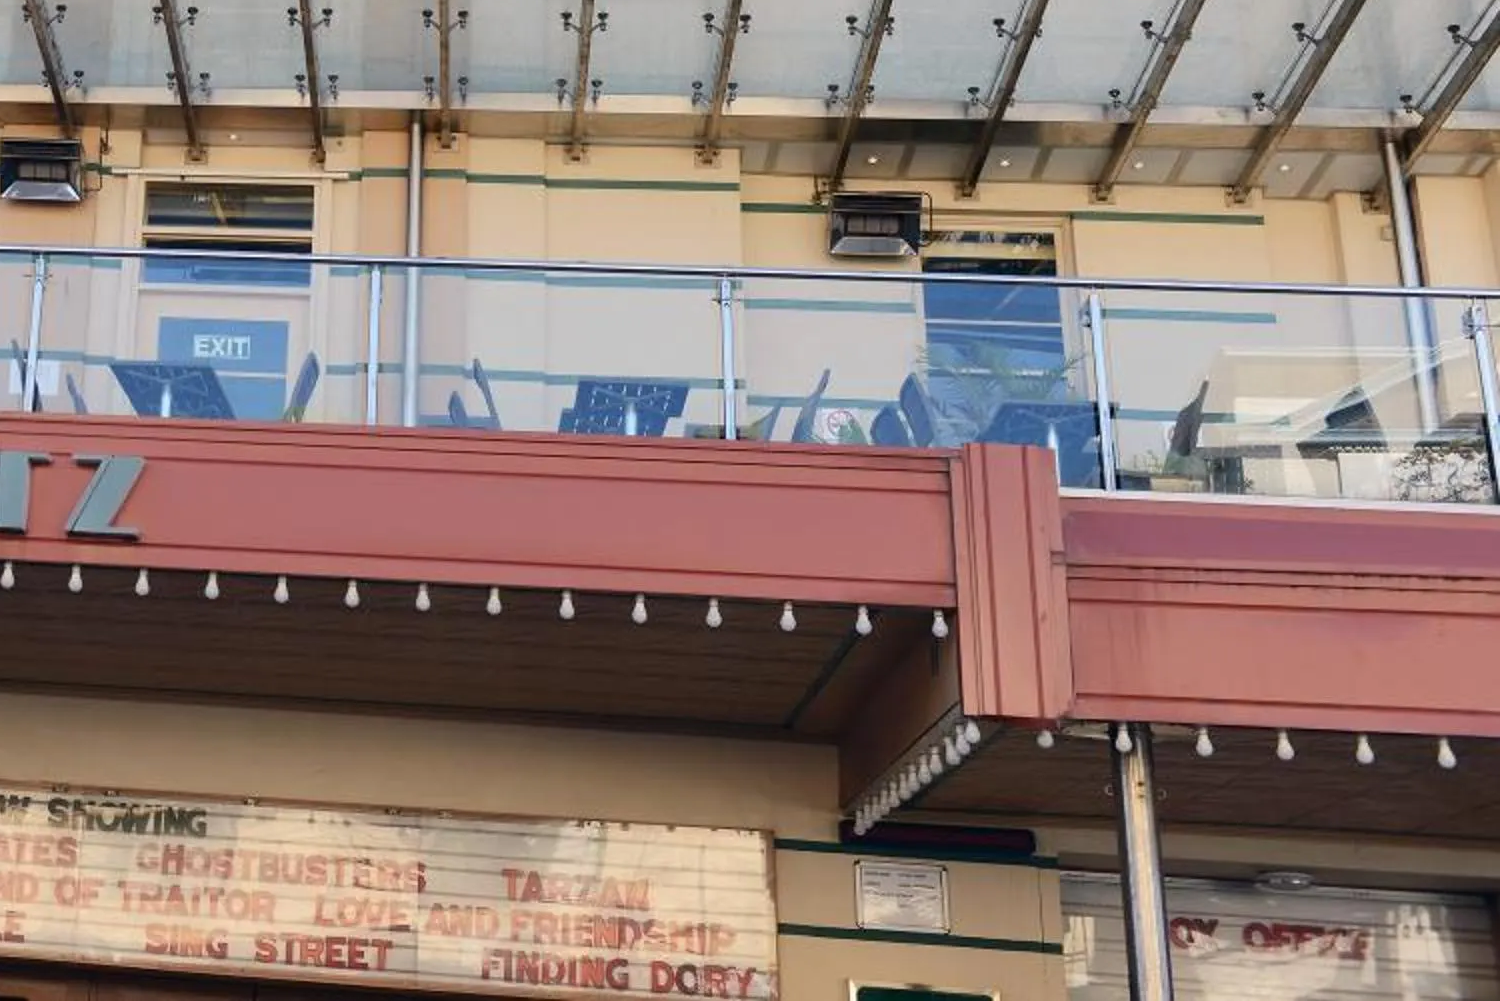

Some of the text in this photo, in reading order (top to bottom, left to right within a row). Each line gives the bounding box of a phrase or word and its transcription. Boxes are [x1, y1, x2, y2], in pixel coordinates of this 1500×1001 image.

[194, 335, 250, 359] EXIT
[47, 798, 207, 838] SHOWING
[136, 842, 427, 894] GHOSTBUSTERS
[53, 875, 104, 907] OF
[118, 881, 276, 924] TRAITOR
[313, 895, 411, 932] LOVE
[425, 902, 499, 938] AND
[510, 908, 737, 957] FRIENDSHIP
[1169, 916, 1220, 950] OX
[145, 923, 229, 960] SING
[254, 933, 393, 971] STREET
[481, 948, 630, 991] FINDING
[650, 960, 756, 999] DORY
